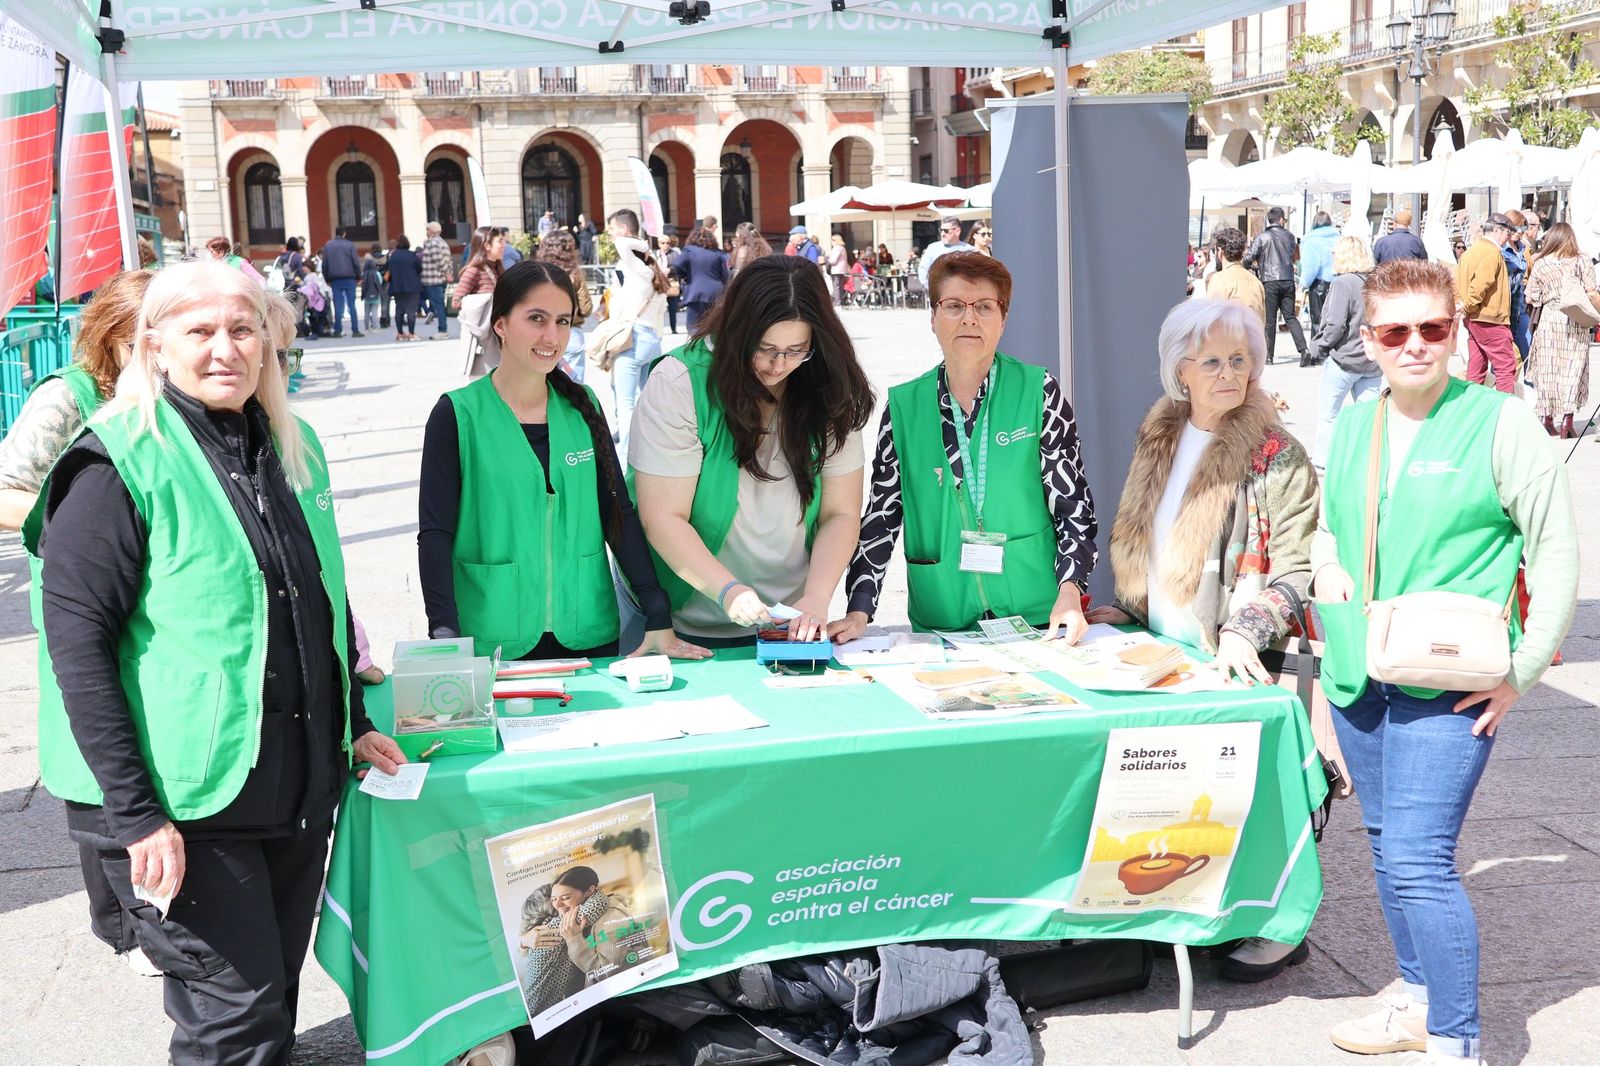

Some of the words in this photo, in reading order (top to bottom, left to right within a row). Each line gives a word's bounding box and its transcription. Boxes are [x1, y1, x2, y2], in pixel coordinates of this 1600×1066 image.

[8, 36, 49, 59] ZAMORA
[1122, 747, 1178, 759] Sabores
[1220, 746, 1237, 757] 21
[1119, 759, 1187, 772] solidarios
[544, 814, 629, 842] Extraordinario
[506, 865, 534, 879] Contigo
[507, 870, 539, 886] personas
[775, 854, 902, 883] asociación
[770, 876, 878, 904] española
[767, 901, 843, 926] contra
[847, 896, 869, 915] el
[873, 890, 954, 912] cáncer
